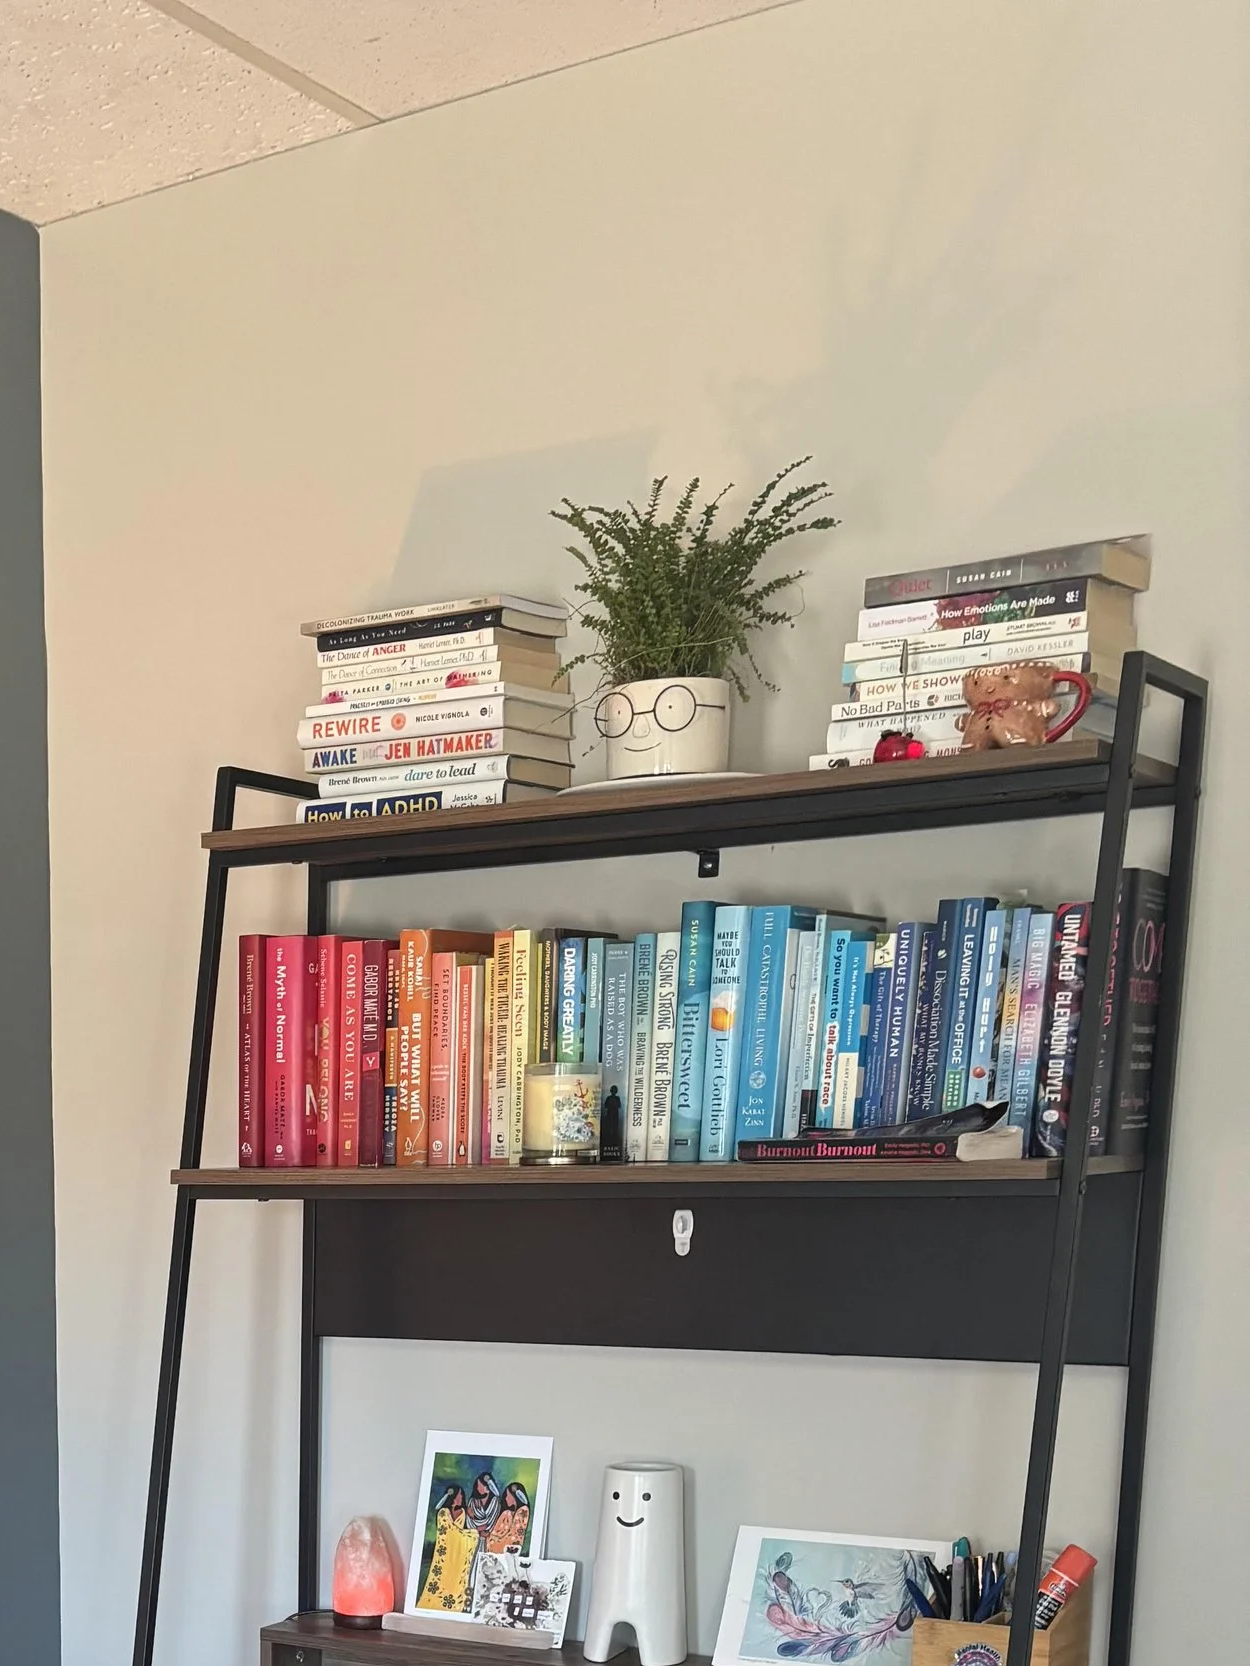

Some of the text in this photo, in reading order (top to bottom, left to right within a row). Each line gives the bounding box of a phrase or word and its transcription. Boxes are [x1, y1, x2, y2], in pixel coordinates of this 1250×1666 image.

[956, 569, 1012, 583] SUSAN CAIN
[317, 609, 414, 629] DECOLONIZING TRAUMA WORK
[941, 595, 1056, 618] How Emotions Are Made
[340, 635, 357, 644] Long
[388, 627, 407, 636] Need
[963, 628, 990, 644] play
[1008, 640, 1074, 655] DAVID KESSLER
[322, 644, 406, 663] The Dance of ANGER
[867, 675, 961, 696] HOW WE SHOW
[313, 716, 382, 739] REWIRE
[416, 710, 470, 723] NICOLE VIGNOLA
[312, 748, 357, 768] AWAKE
[384, 742, 411, 760] JEN
[417, 733, 493, 753] HATMAKER
[328, 776, 350, 786] Brené
[352, 775, 377, 784] Brown
[404, 769, 433, 782] dare
[436, 768, 446, 779] to
[448, 763, 477, 777] lead
[307, 796, 438, 822] How to ADHD
[452, 793, 478, 802] Jessica
[717, 931, 739, 940] MAYBE
[1058, 914, 1082, 981] UNTAMED
[687, 919, 699, 988] SUSAN CAIN
[715, 948, 740, 957] SHOULD
[715, 958, 737, 968] TALK
[959, 934, 974, 985] LEAVING
[1028, 928, 1045, 990] BIG MAGIC
[245, 954, 255, 1014] Brené Brown
[275, 966, 286, 999] Myth
[346, 954, 356, 1000] COME
[637, 944, 651, 1016] BRENÉ BROWN
[658, 949, 678, 1031] RISING STRONG
[712, 976, 741, 984] SOMEONE
[877, 971, 885, 985] The
[958, 987, 968, 999] IT
[276, 1002, 284, 1012] of
[514, 950, 526, 1037] Feeling Seen
[562, 948, 576, 1055] DARING GREATLY
[607, 977, 615, 1016] RAISED
[618, 997, 626, 1017] BOY
[876, 1004, 883, 1012] of
[889, 929, 910, 1058] UNIQUELY HUMAN
[929, 971, 946, 1040] Dissociation
[346, 1006, 355, 1025] AS
[440, 990, 449, 1051] BOUNDARIES,
[496, 942, 510, 1090] WAKING THE TIGER: HEALING TRAUMA
[606, 1018, 615, 1033] AS
[810, 1024, 814, 1032] OF
[822, 938, 845, 1106] So you want to talk about race
[872, 1013, 882, 1043] Therapy
[998, 958, 1020, 1100] MAN'S SEARCH FOR MEAN
[275, 1015, 286, 1063] Normal
[345, 1027, 355, 1063] YOU
[617, 1021, 625, 1046] WHO
[636, 1032, 647, 1066] BRAVING
[951, 1023, 965, 1064] OFFICE
[1044, 992, 1072, 1103] GLENNON DOYLE
[399, 1026, 410, 1111] PEOPLE SAY?
[410, 1013, 421, 1122] BUT WHAT WILL
[605, 1044, 614, 1067] DOG
[616, 1049, 624, 1072] WAS
[656, 1042, 673, 1077] BRENÉ
[678, 1002, 700, 1111] Bittersweet
[804, 1033, 815, 1080] Imperfection
[925, 1041, 940, 1073] Made
[1015, 1003, 1038, 1117] ELIZABETH GILBERT
[344, 1069, 354, 1101] ARE
[655, 1078, 672, 1117] BROWN
[710, 1038, 728, 1136] Lori Gottlieb
[749, 1095, 764, 1105] JON
[921, 1074, 937, 1110] Simple
[632, 1078, 644, 1127] WILDERNESS
[744, 1117, 765, 1126] ZINN
